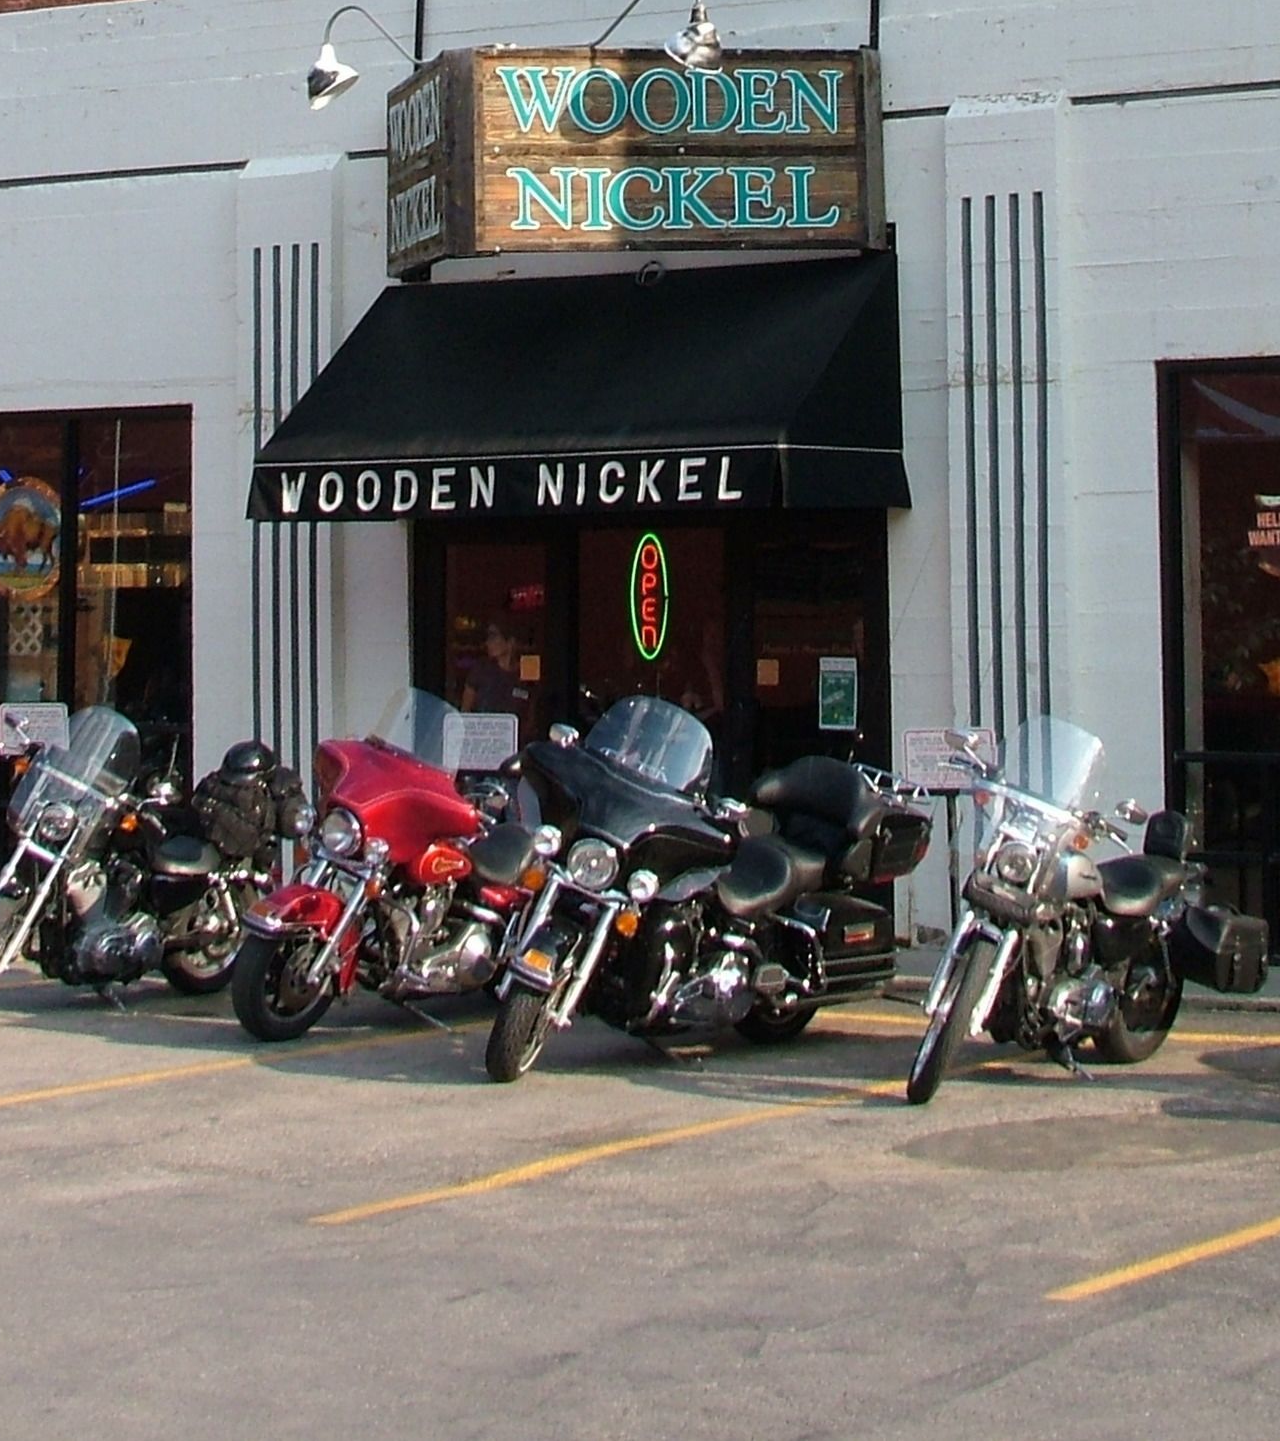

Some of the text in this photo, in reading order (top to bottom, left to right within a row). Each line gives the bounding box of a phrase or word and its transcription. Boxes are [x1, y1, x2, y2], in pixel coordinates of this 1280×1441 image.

[389, 74, 441, 162] WOODEN
[495, 66, 844, 134] WOODEN
[389, 174, 442, 254] NICKEL
[506, 166, 840, 231] NICKEL
[281, 456, 743, 514] WOODEN NICKEL
[641, 543, 658, 649] OPEN
